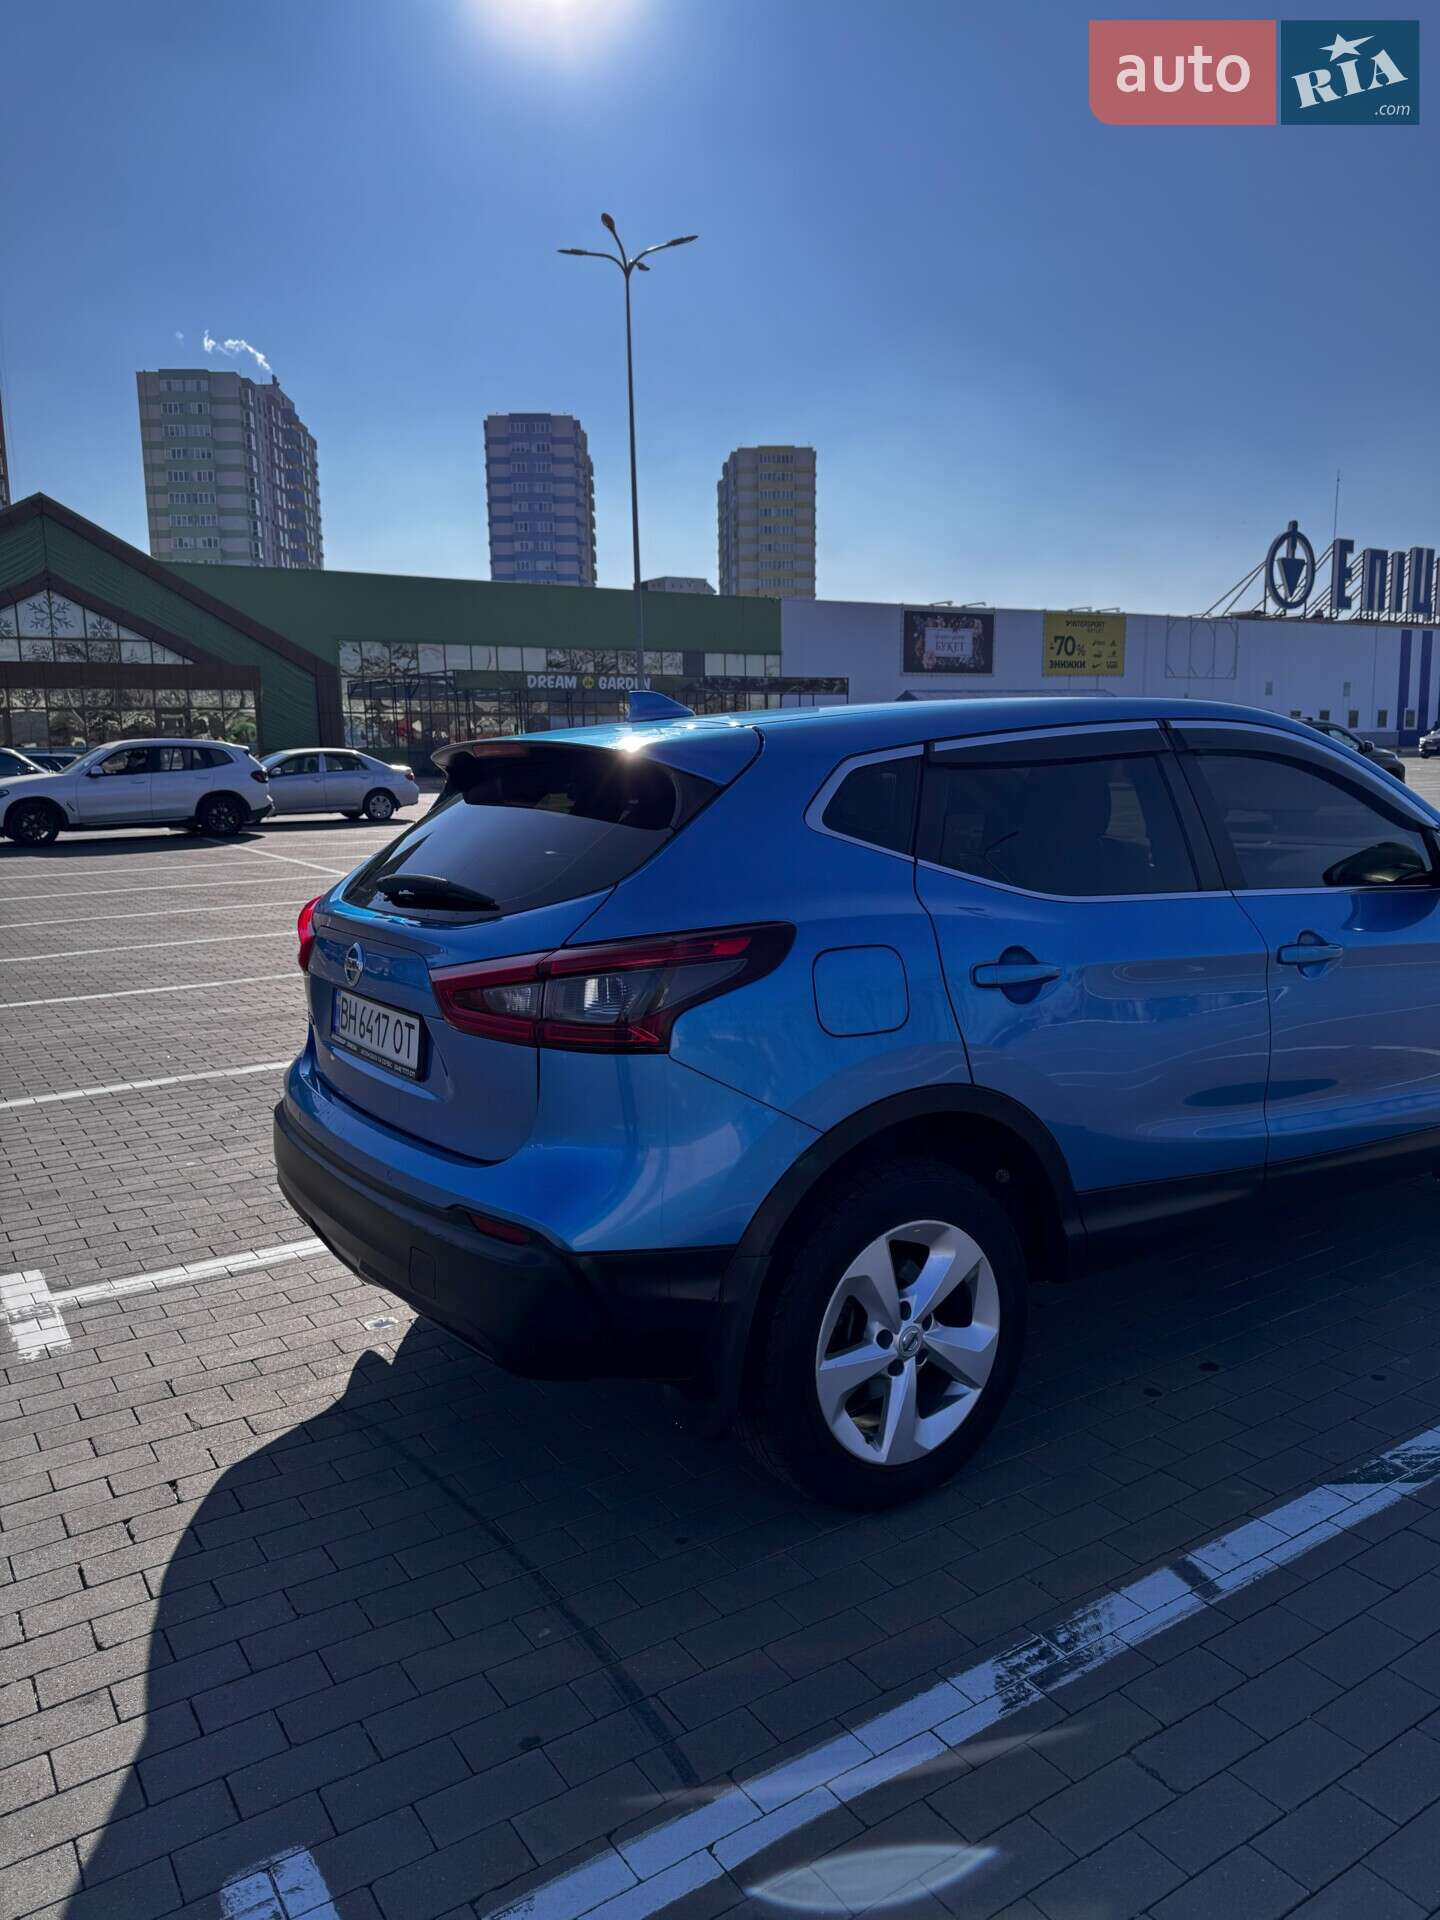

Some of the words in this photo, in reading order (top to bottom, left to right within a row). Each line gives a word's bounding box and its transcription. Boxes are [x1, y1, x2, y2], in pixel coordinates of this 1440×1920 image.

[1331, 538, 1440, 621] Епіц
[1049, 659, 1086, 669] ЗНИЖКИ
[527, 674, 577, 689] DREAM
[393, 1019, 415, 1059] OT
